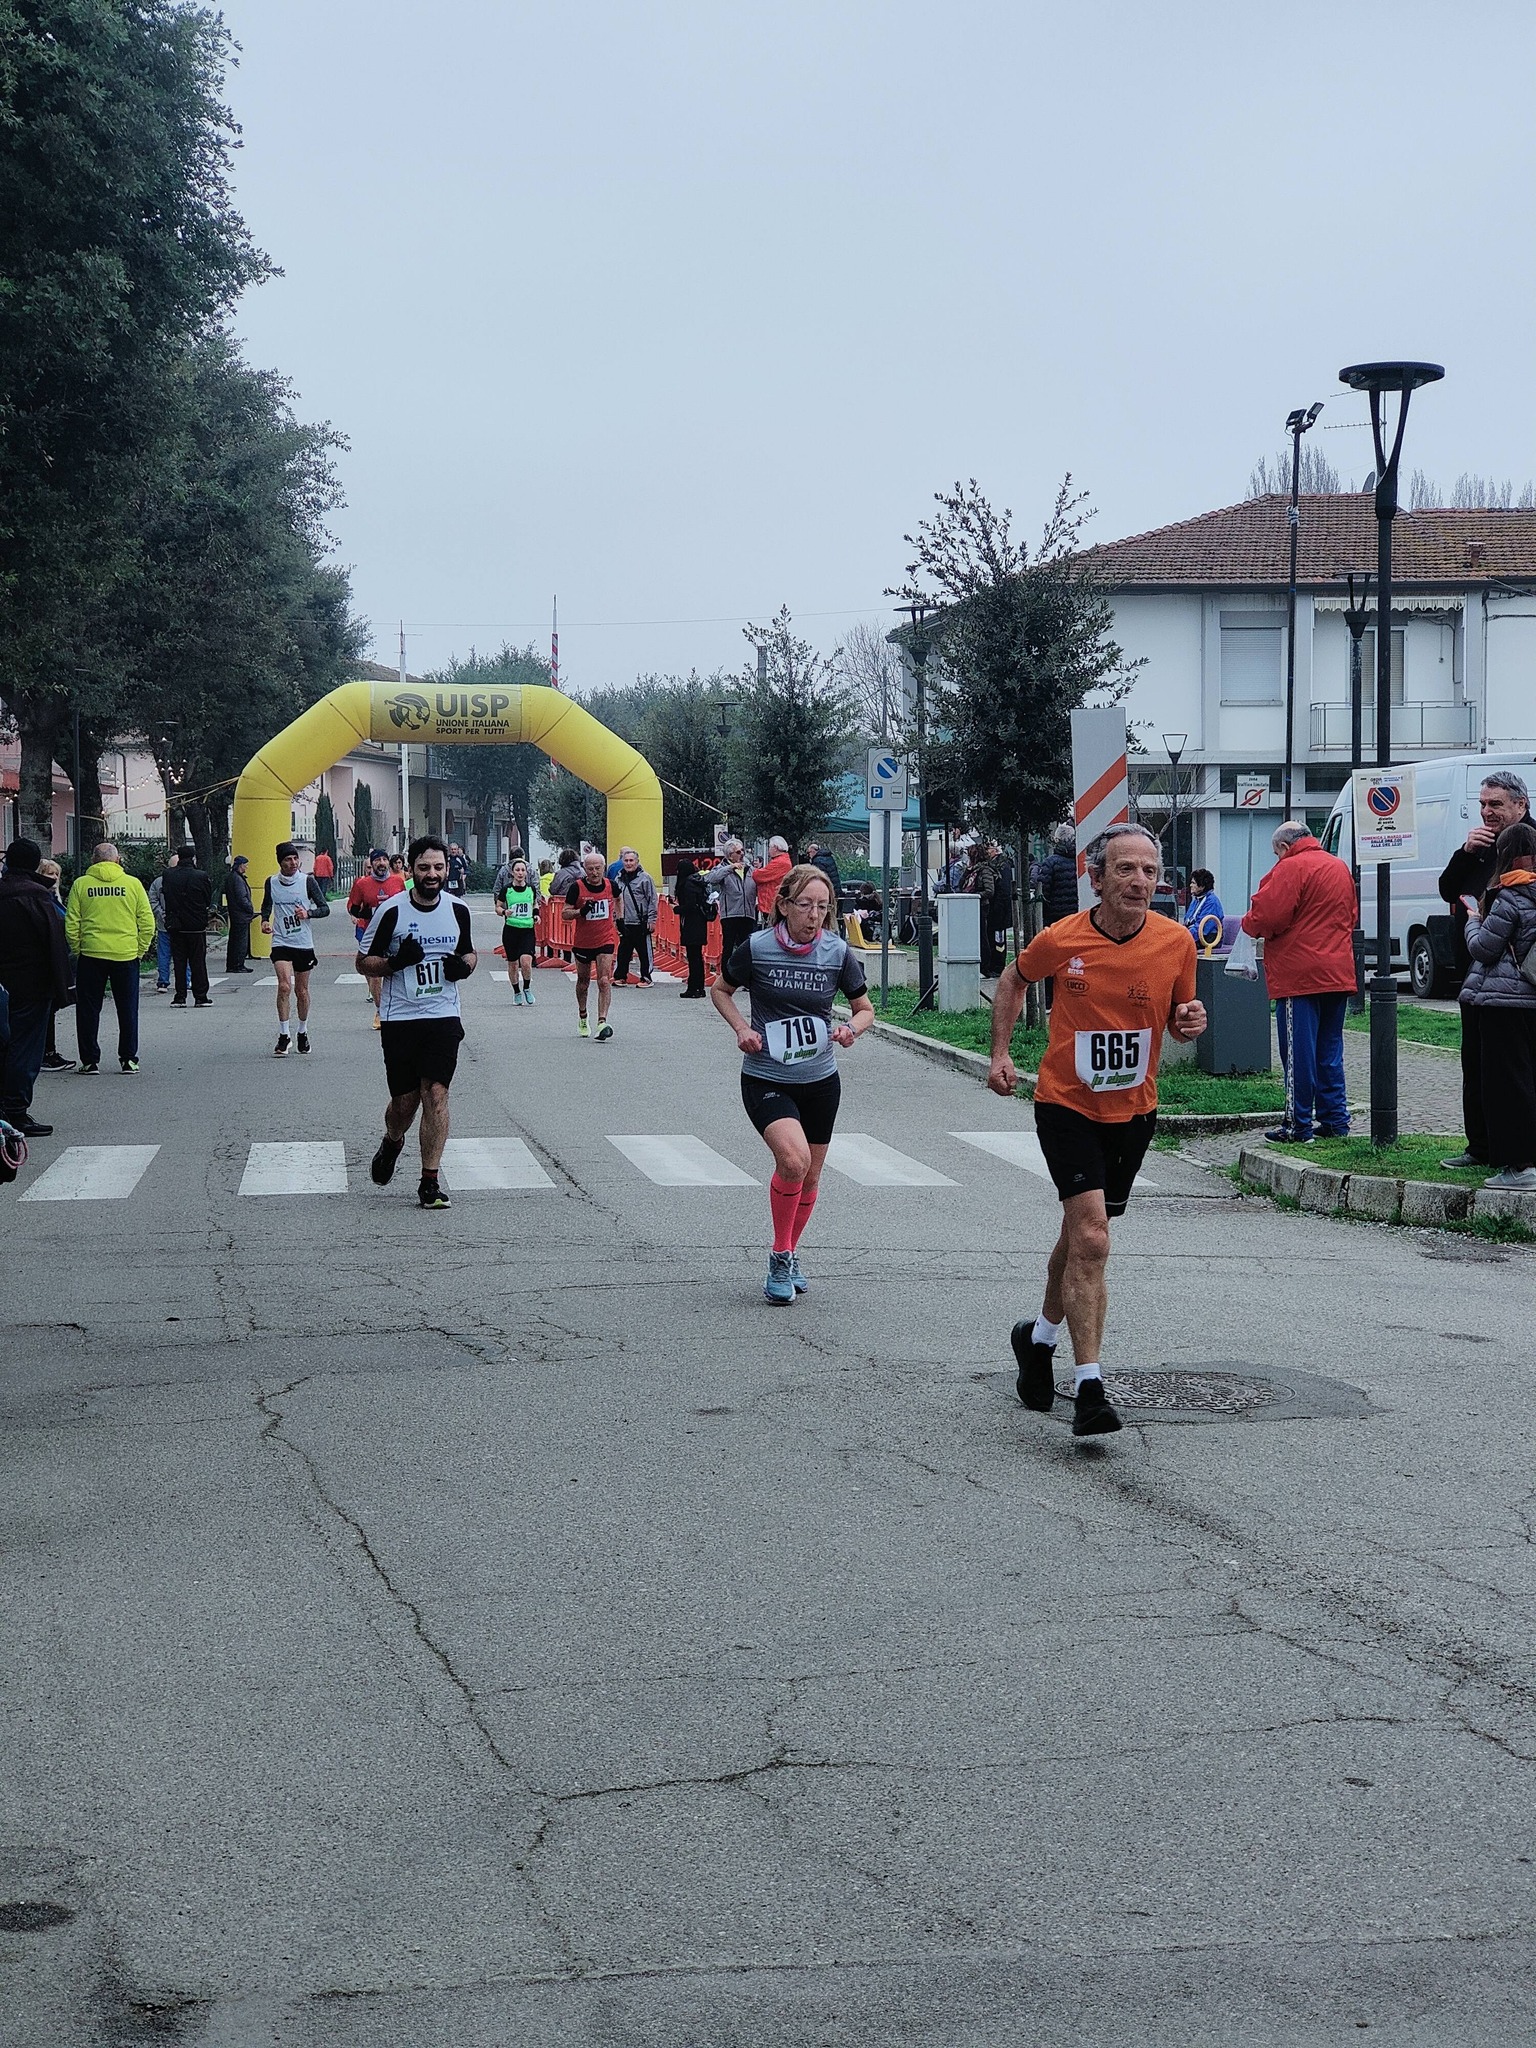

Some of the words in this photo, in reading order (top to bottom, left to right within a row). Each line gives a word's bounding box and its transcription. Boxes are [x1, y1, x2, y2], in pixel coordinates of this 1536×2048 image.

[435, 693, 510, 718] UISP
[435, 719, 469, 727] UNIONE
[472, 719, 510, 728] ITALIANA
[435, 727, 462, 735] SPORT
[87, 886, 126, 898] GIUDICE
[515, 903, 528, 913] 738
[415, 961, 440, 986] 617
[768, 969, 828, 982] ATLETICA
[773, 978, 824, 992] MAMELI
[1066, 980, 1086, 991] LUCCI
[781, 1017, 817, 1049] 719
[1090, 1032, 1140, 1071] 665
